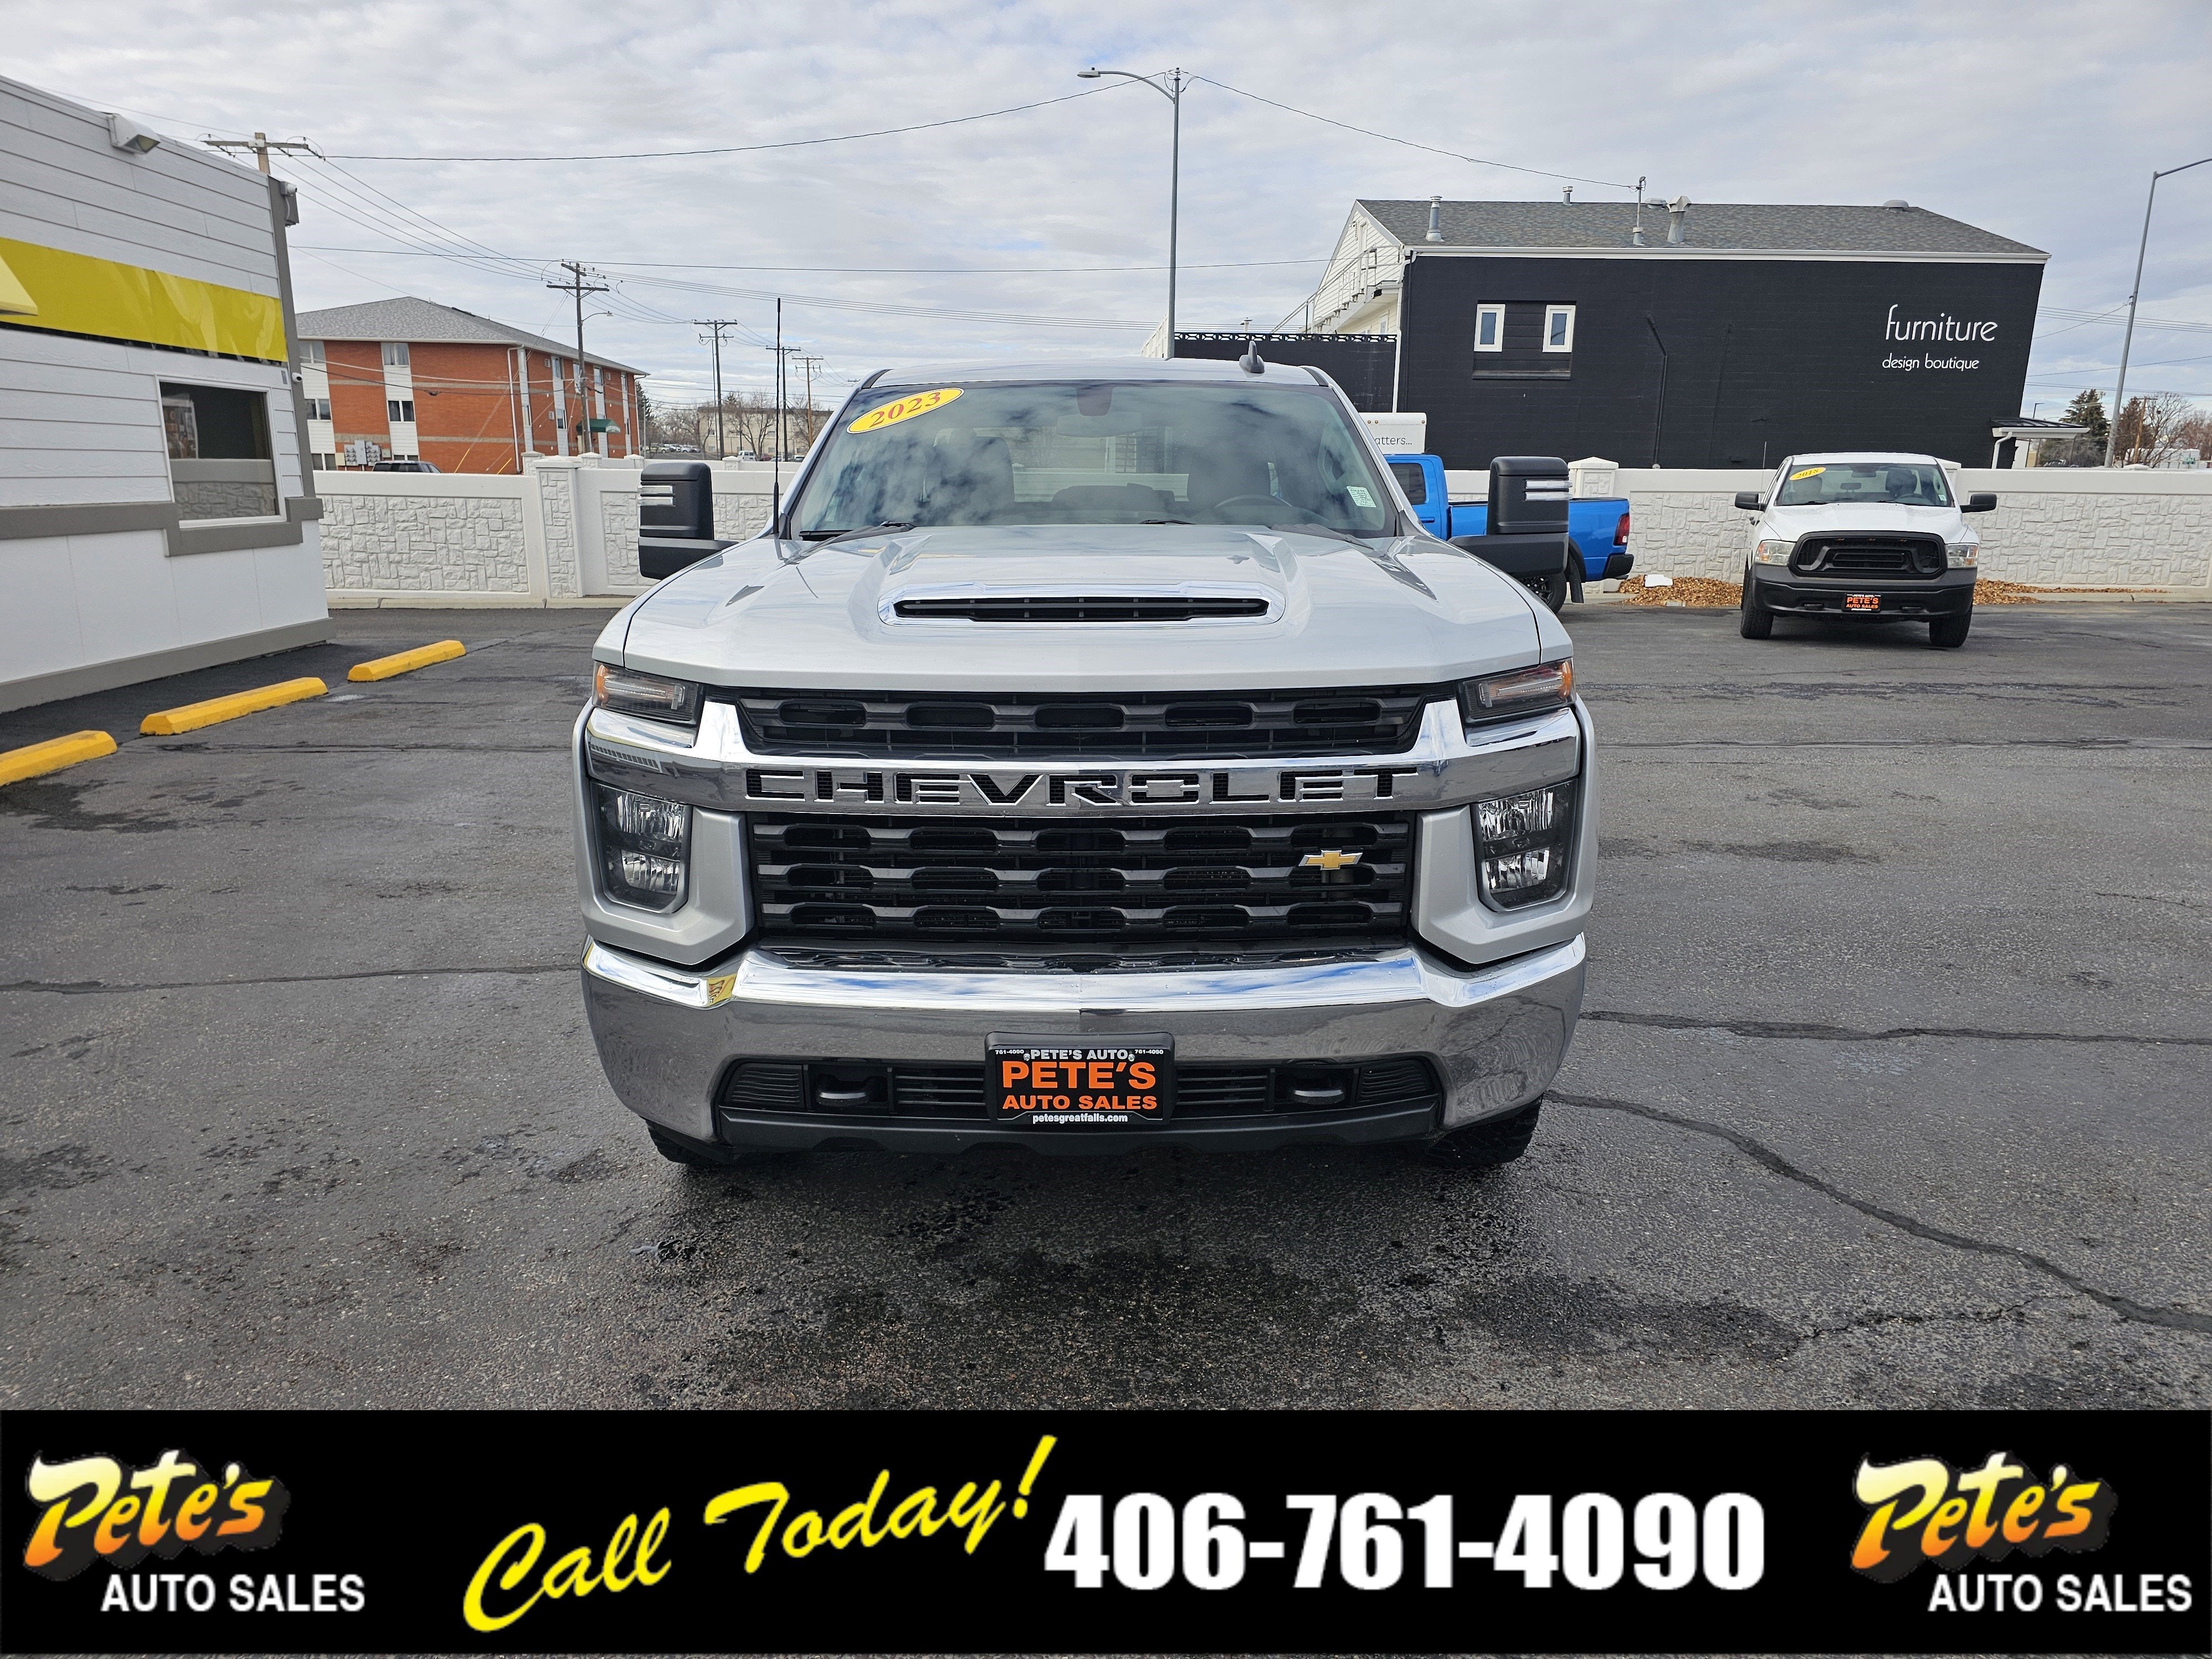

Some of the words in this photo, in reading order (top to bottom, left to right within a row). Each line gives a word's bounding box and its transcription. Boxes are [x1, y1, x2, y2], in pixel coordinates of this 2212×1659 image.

[1885, 304, 1998, 342] furniture
[1882, 352, 1920, 372] design
[1924, 352, 1980, 372] boutique
[868, 392, 941, 428] 2023
[1374, 436, 1412, 445] atters...
[744, 766, 1419, 806] CHEVROLET
[1030, 1049, 1082, 1060] PETE'S
[1087, 1049, 1128, 1060] AUTO
[1002, 1061, 1156, 1089] PETE'S
[1002, 1095, 1070, 1109] AUTO
[1078, 1095, 1157, 1110] SALES
[1032, 1113, 1128, 1124] petesgreatfalls.com
